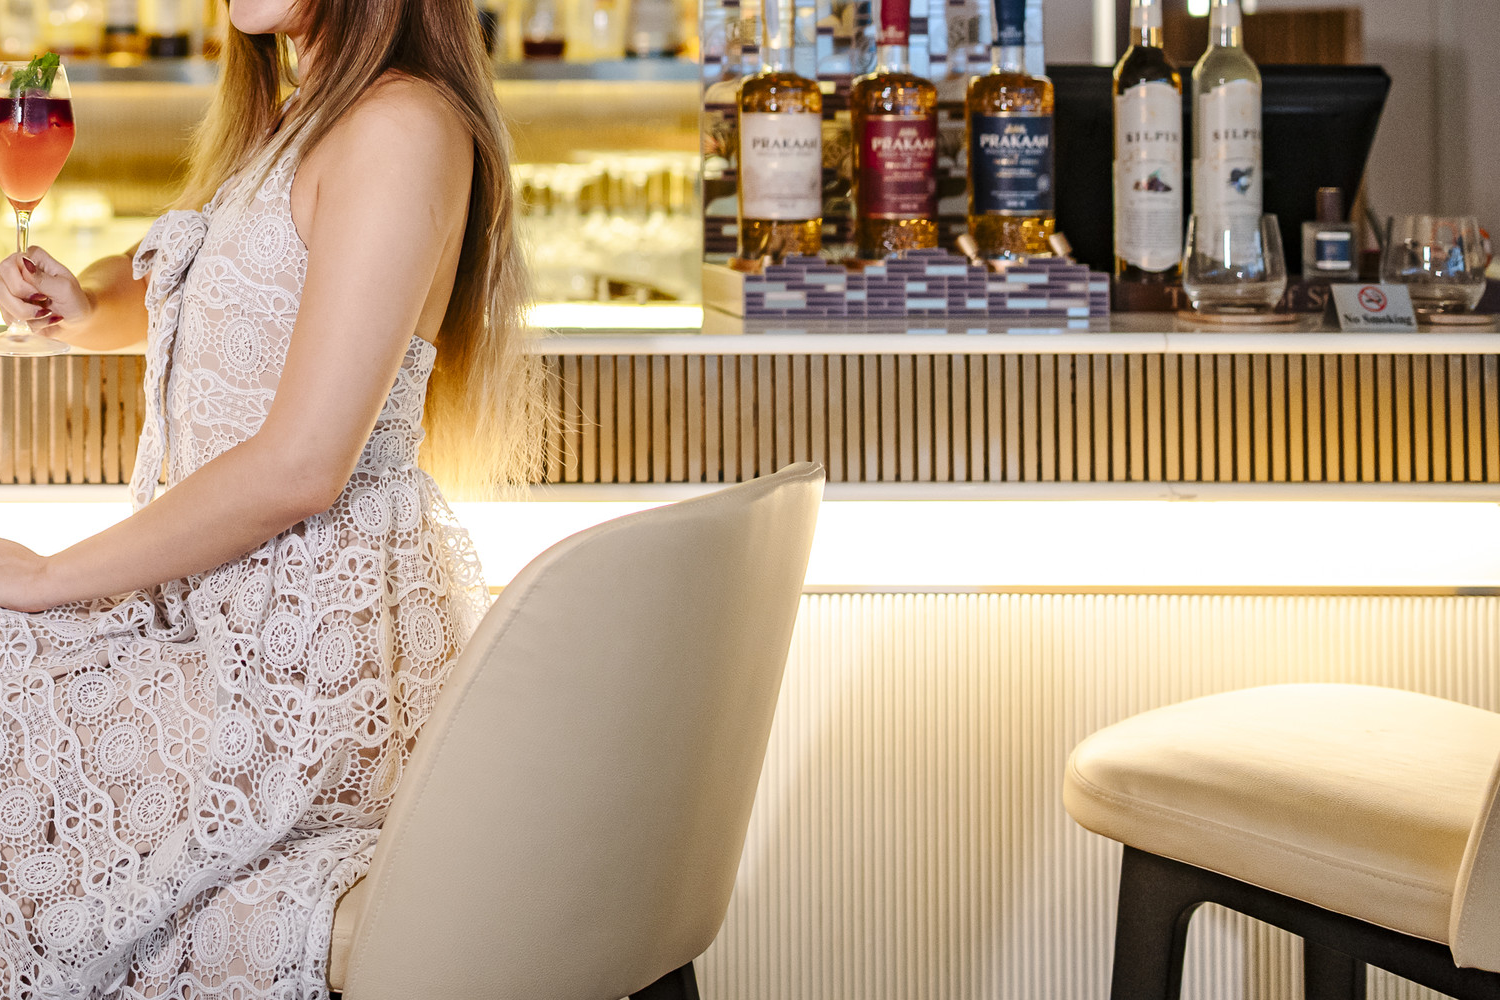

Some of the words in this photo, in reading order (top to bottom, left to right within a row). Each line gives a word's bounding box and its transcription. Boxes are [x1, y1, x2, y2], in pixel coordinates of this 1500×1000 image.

[752, 137, 818, 150] PRAKAAN
[871, 136, 936, 151] PRAKAAN
[980, 133, 1048, 148] PRAKAAN
[1344, 313, 1360, 324] No
[1362, 313, 1414, 326] Smoking
